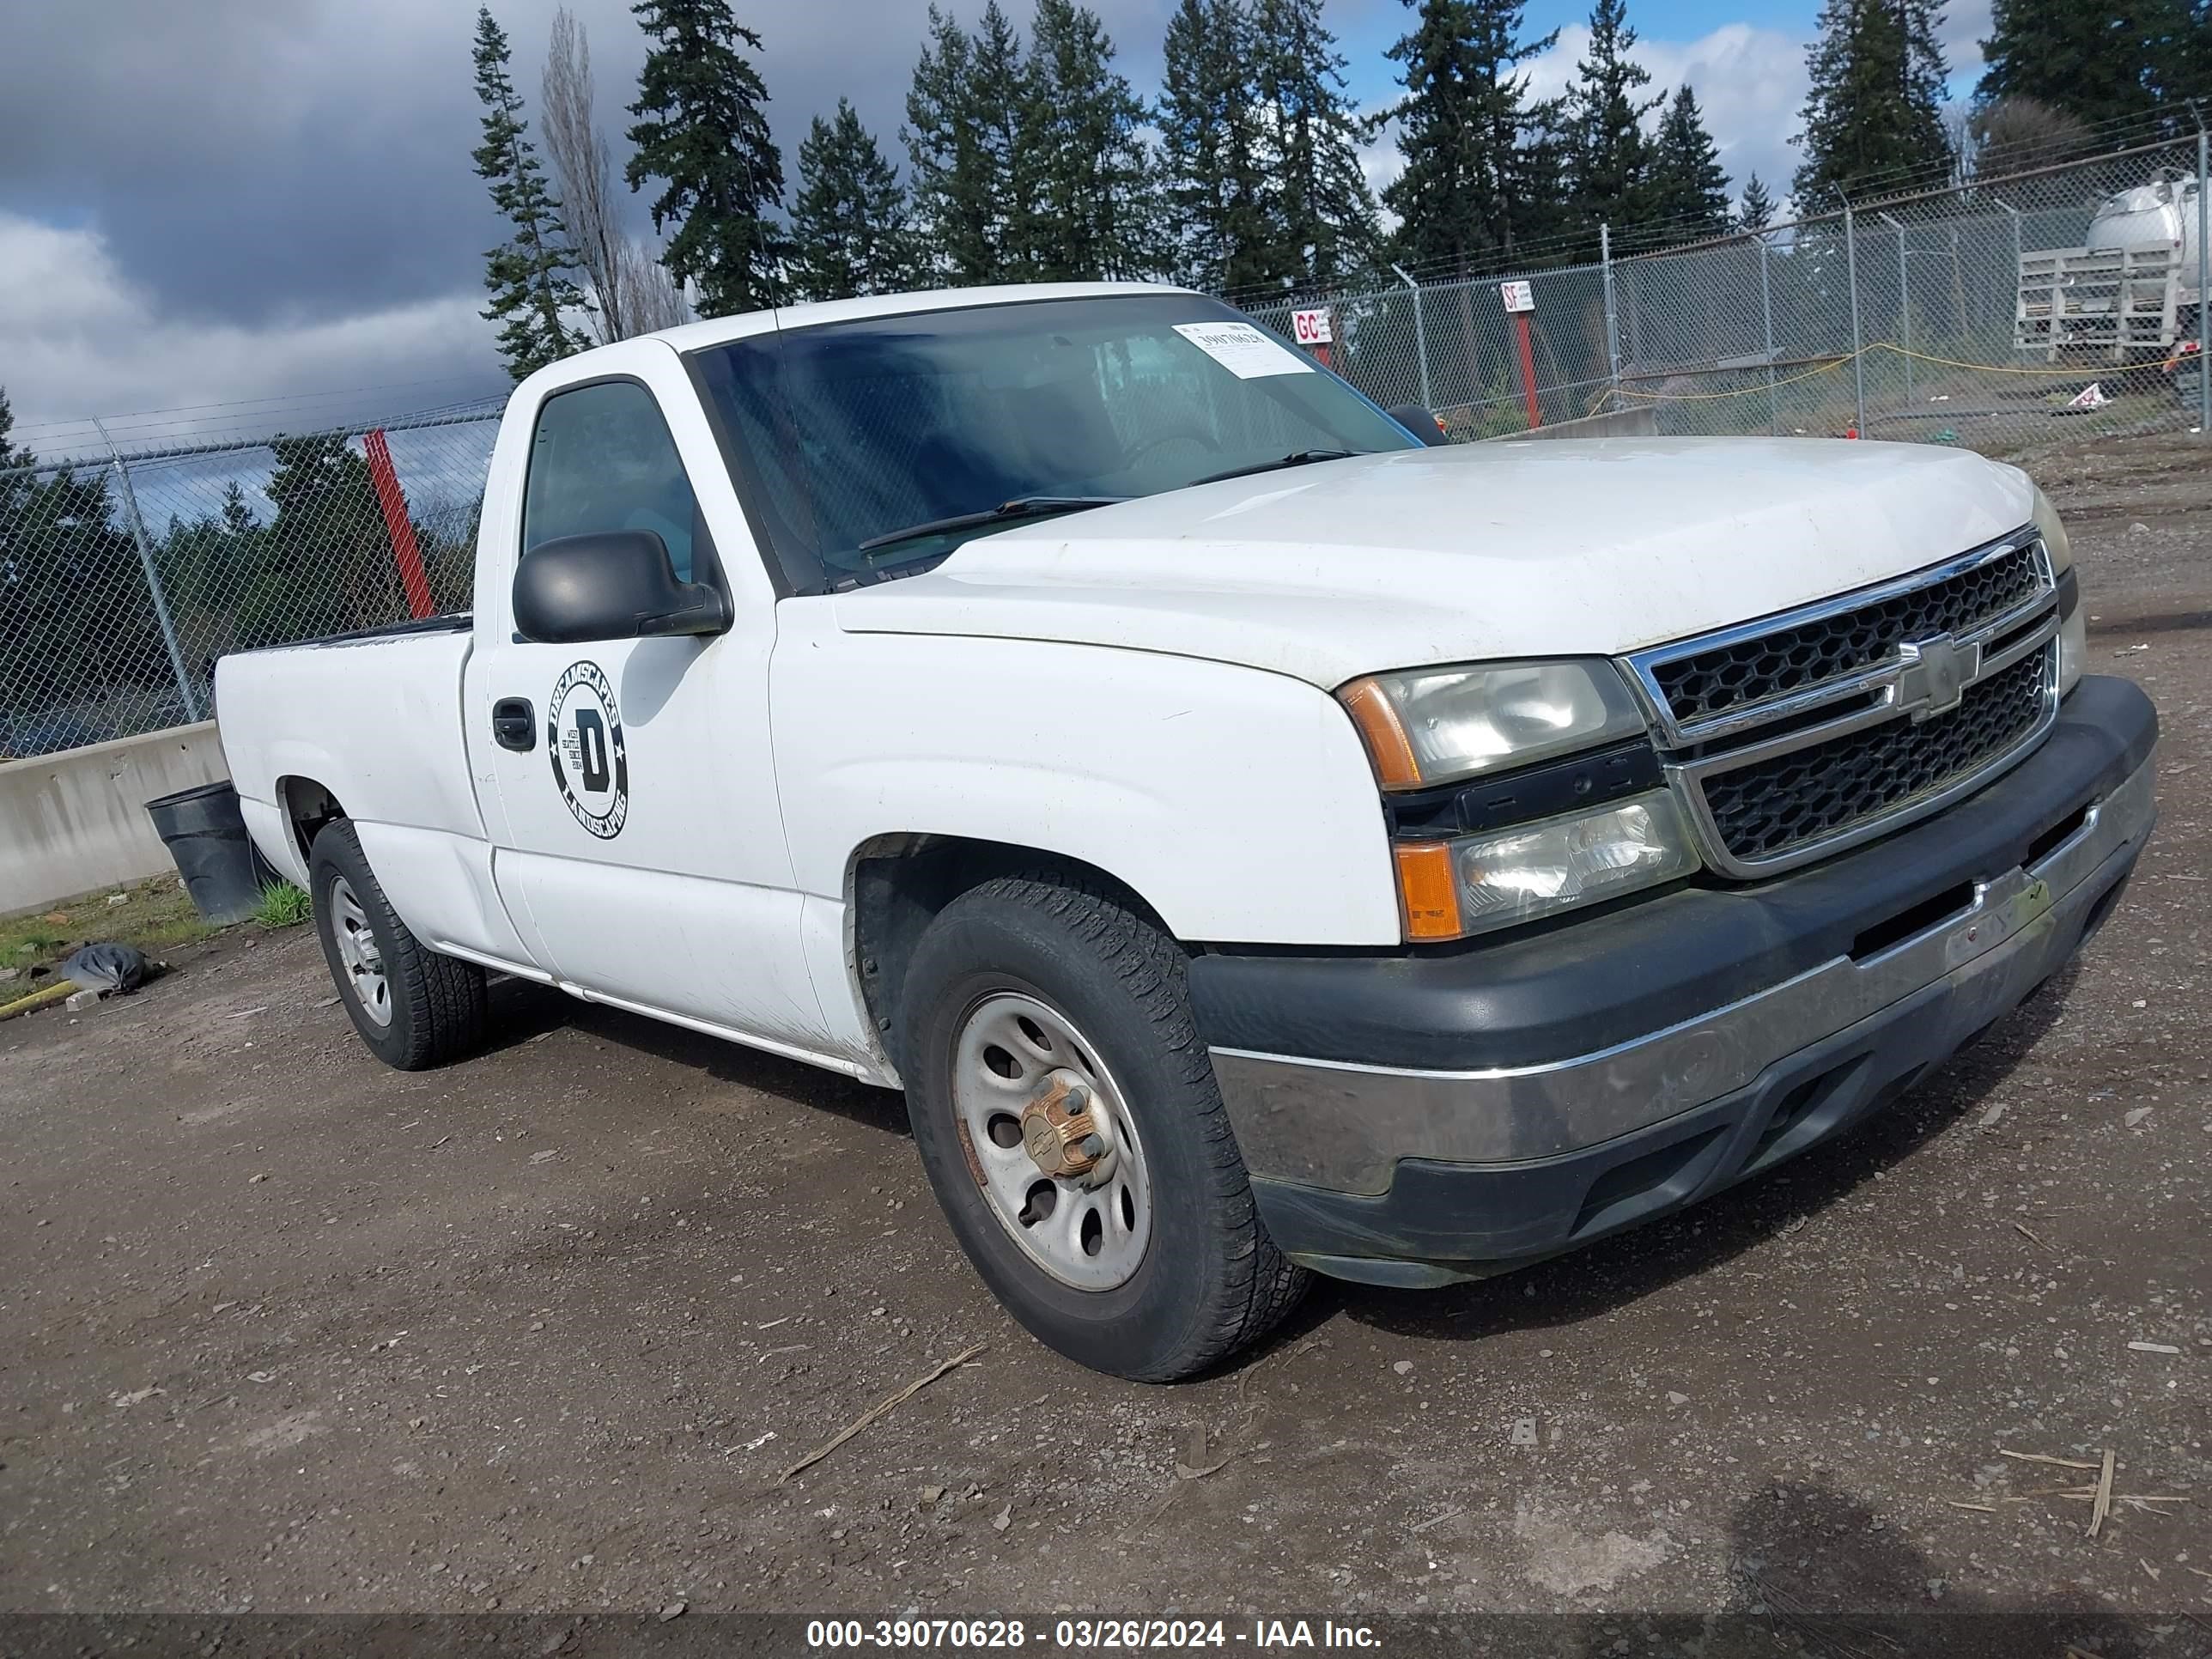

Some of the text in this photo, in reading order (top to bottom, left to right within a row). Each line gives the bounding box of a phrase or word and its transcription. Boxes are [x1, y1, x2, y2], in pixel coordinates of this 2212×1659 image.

[1297, 314, 1318, 339] GC
[1198, 333, 1265, 346] 39070628
[549, 662, 620, 729] DREAMSCAPES
[567, 729, 579, 738] WEST
[562, 739, 580, 749] SEATTLE
[575, 708, 611, 793] D
[569, 750, 581, 759] SINCE
[562, 783, 627, 838] LANDSCAPING
